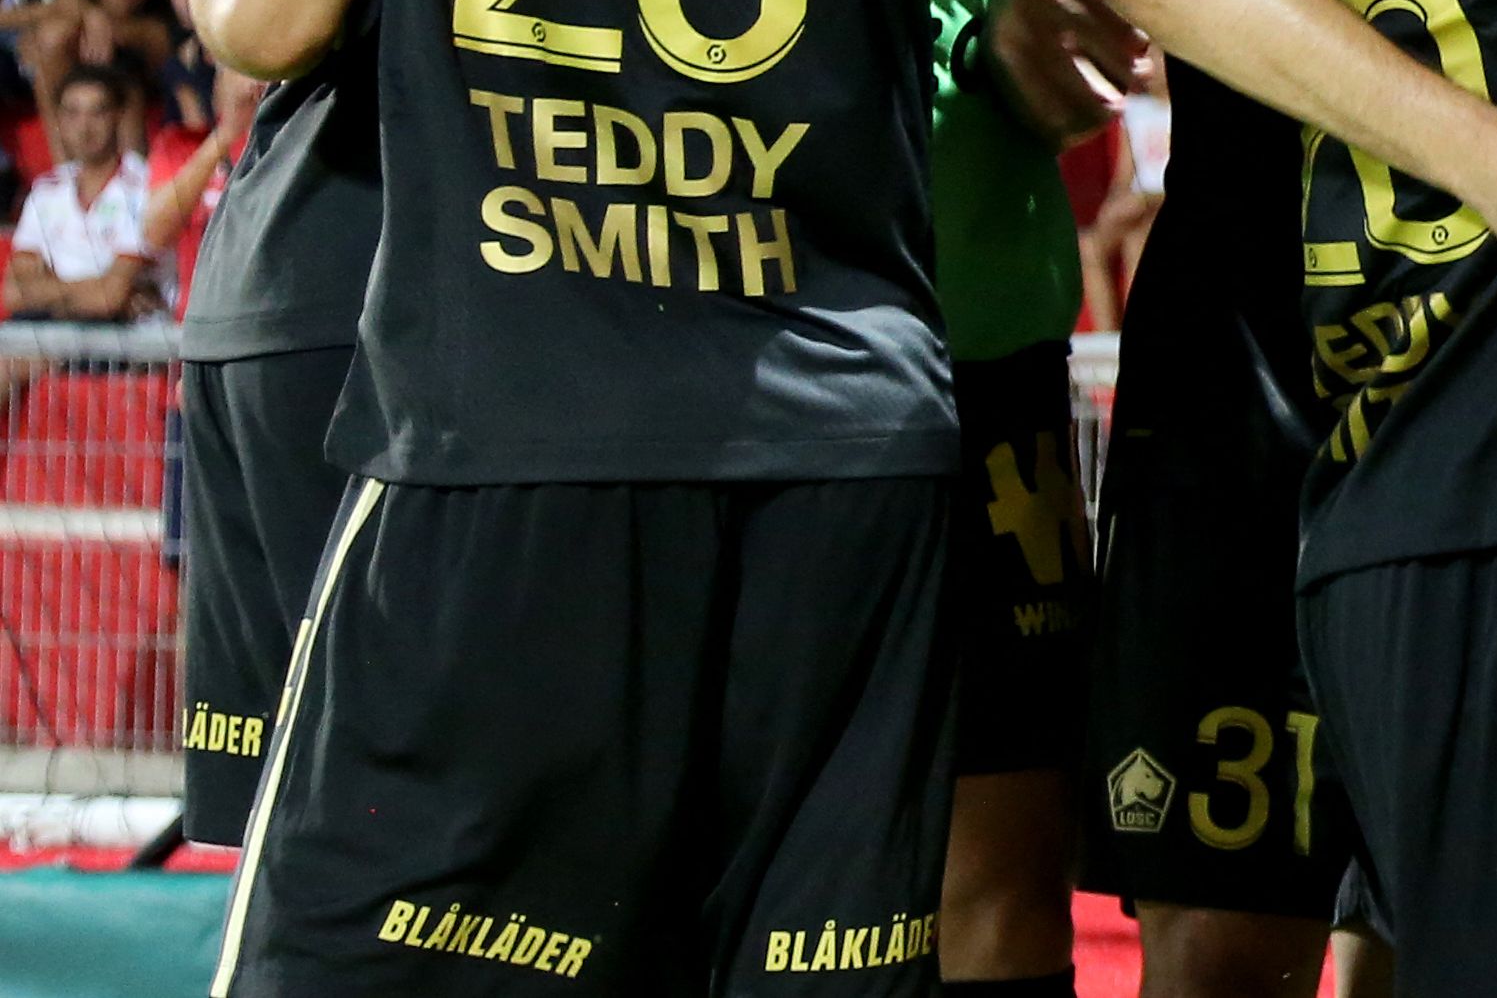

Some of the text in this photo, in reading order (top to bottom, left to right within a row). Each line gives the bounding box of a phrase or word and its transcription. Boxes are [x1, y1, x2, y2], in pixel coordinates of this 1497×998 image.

[470, 90, 810, 200] TEDDY
[480, 187, 797, 298] SMITH
[1187, 706, 1319, 857] 31
[378, 899, 593, 979] BLÅKLÄDER
[764, 913, 939, 972] BLÅKLÄDE
